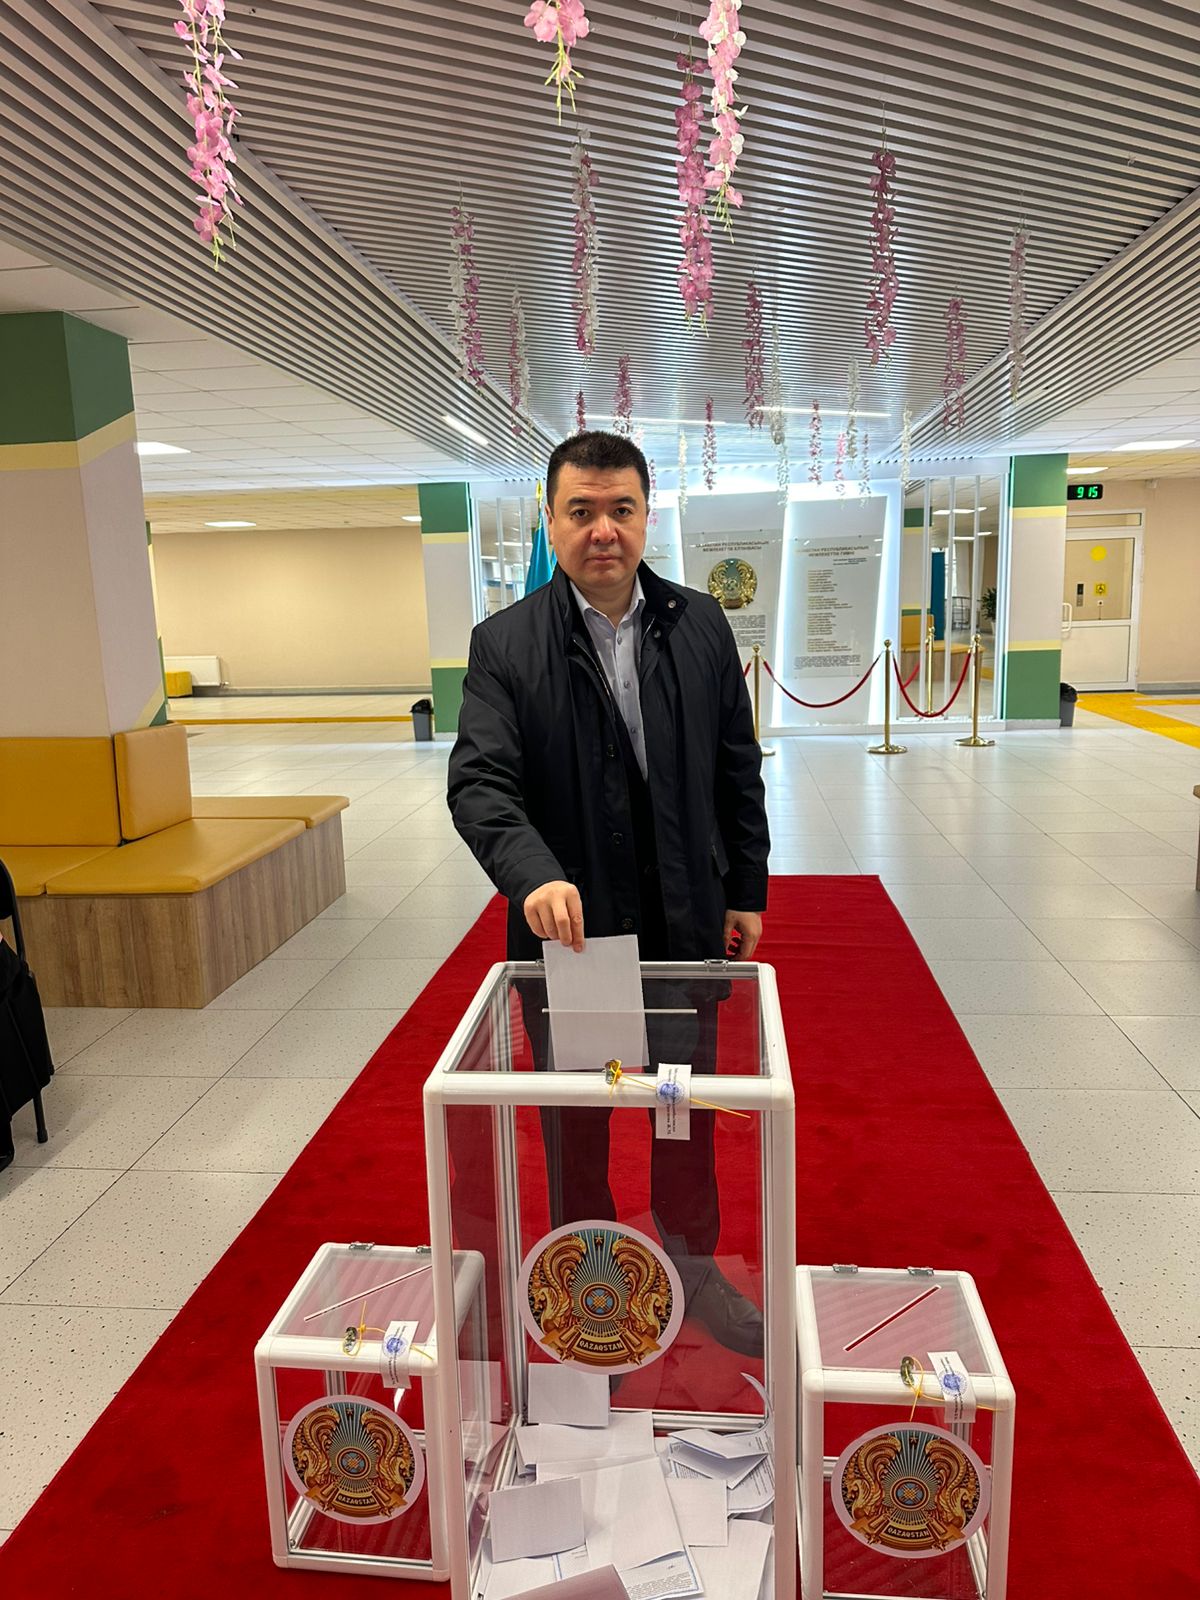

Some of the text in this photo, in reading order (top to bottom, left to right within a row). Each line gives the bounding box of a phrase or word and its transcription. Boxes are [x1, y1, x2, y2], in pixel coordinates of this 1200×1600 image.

[1077, 485, 1098, 498] 9 15
[579, 1339, 624, 1352] QAZAQSTAN
[337, 1494, 375, 1505] QAZAQSTAN
[887, 1527, 929, 1538] QAZAQSTAN
